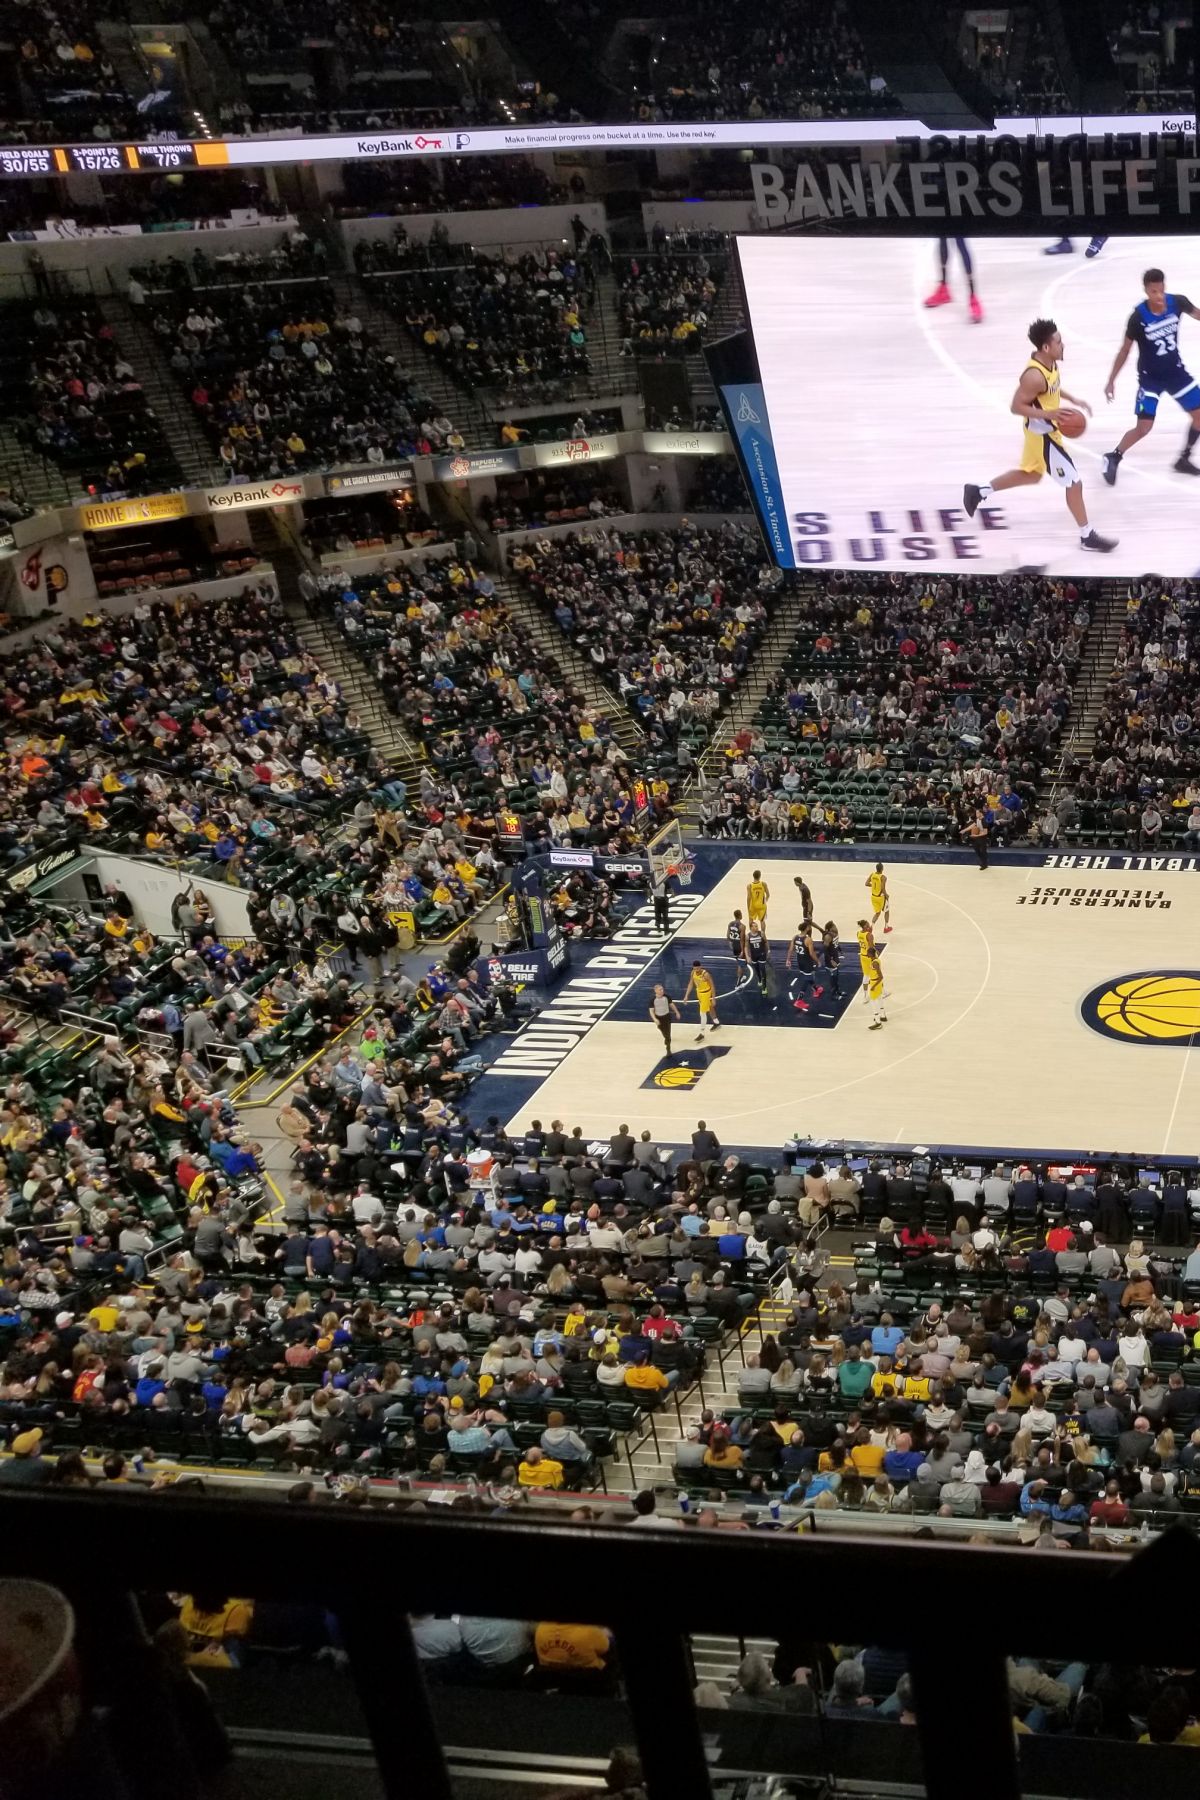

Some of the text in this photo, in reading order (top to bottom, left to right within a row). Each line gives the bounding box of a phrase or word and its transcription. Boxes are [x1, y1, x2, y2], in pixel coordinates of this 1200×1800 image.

[505, 136, 525, 144] Make
[526, 134, 557, 143] financial
[559, 133, 590, 143] progress
[607, 132, 631, 140] bucket
[72, 147, 119, 157] 3-POINT FG
[138, 144, 192, 155] FREE THROWS
[357, 139, 413, 154] KeyBank
[22, 150, 50, 159] GOALS
[155, 153, 180, 167] 7/9
[3, 158, 49, 173] 30/55
[76, 156, 120, 170] 15/26
[750, 161, 1022, 218] BANKERS
[1037, 158, 1159, 217] LIFE
[1154, 334, 1176, 356] 23
[207, 488, 270, 508] KeyBank
[751, 438, 785, 553] Ascension St. Vincent
[85, 506, 123, 526] HOME
[868, 508, 1010, 534] LIFE
[38, 849, 76, 876] Cadillac
[604, 863, 643, 872] GEICO
[1042, 855, 1110, 869] HERE
[1031, 887, 1164, 899] FIELDHOUSE
[1016, 895, 1172, 909] BANKERS LIFE
[547, 937, 566, 962] BELLE
[551, 949, 565, 969] TIRE
[507, 964, 539, 973] BELLE
[511, 973, 535, 981] TIRE
[485, 975, 632, 1077] INDIANA
